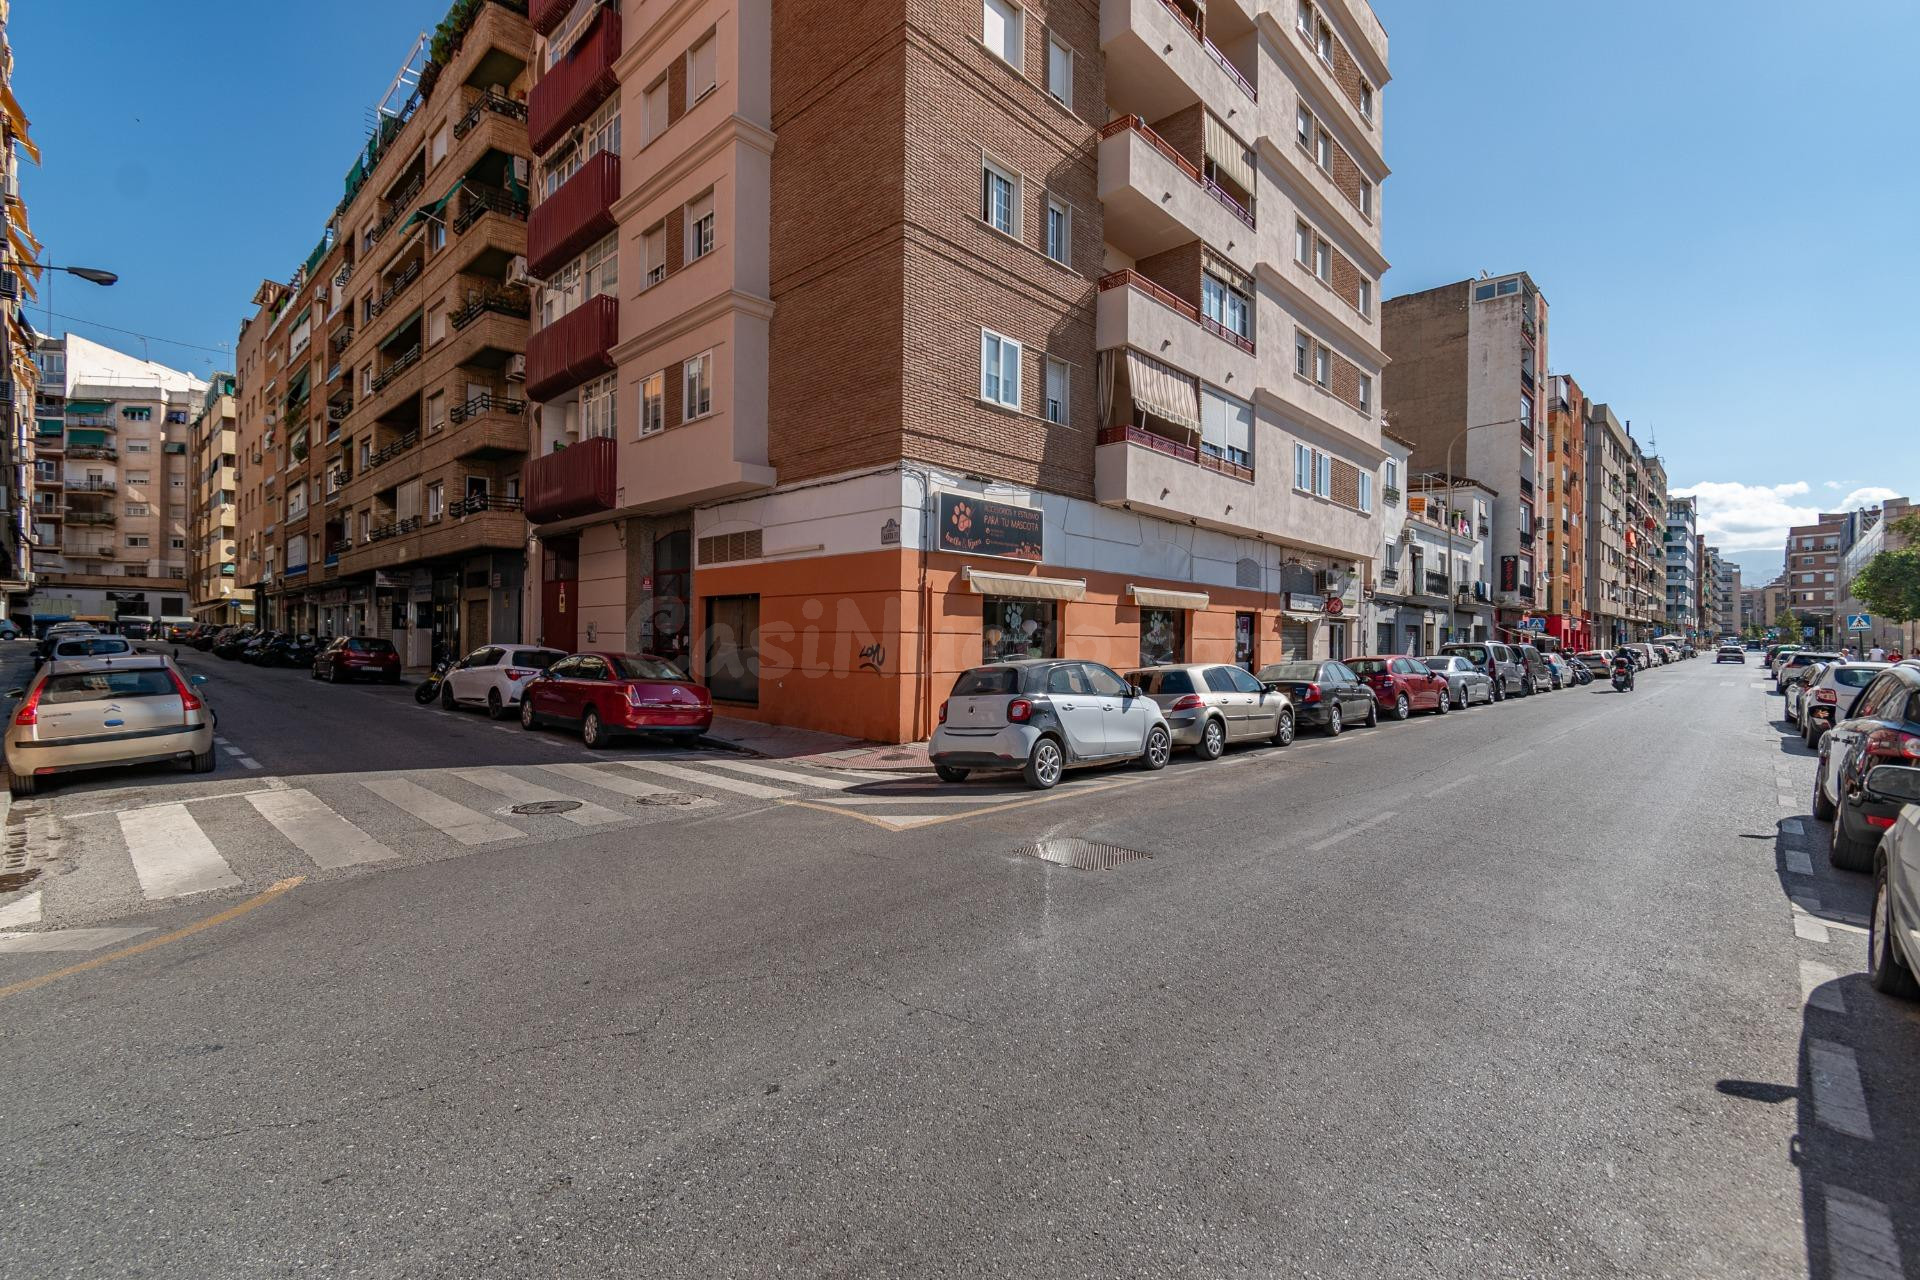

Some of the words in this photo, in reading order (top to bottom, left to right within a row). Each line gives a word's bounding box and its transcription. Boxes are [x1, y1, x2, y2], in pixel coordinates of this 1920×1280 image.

[984, 514, 999, 526] PARA
[1001, 517, 1010, 528] TU
[1010, 519, 1039, 532] MASCOTA
